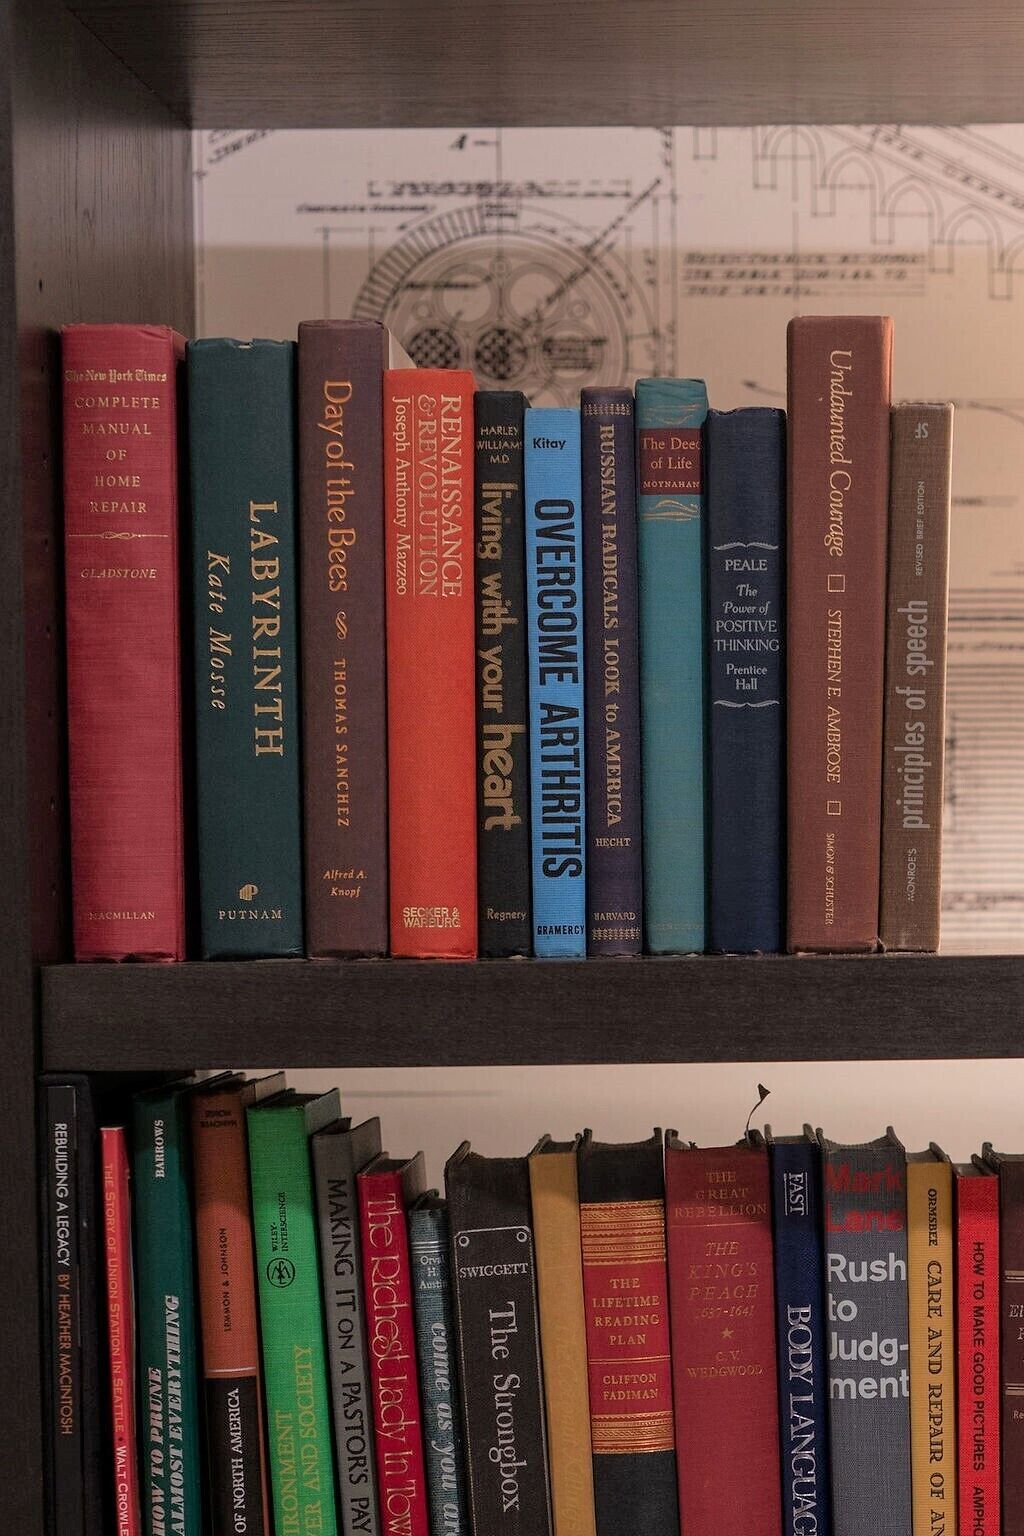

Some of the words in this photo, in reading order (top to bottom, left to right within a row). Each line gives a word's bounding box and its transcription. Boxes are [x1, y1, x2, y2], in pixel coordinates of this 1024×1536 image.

[75, 397, 160, 409] COMPLETE
[319, 380, 352, 437] Day
[393, 396, 411, 454] Joseph
[417, 394, 434, 413] &
[829, 350, 852, 465] Undaunted
[83, 424, 152, 435] MANUAL
[533, 437, 566, 451] Kitay
[107, 450, 127, 461] OF
[325, 442, 353, 470] of
[599, 425, 615, 514] RUSSIAN
[95, 476, 140, 487] HOME
[327, 475, 355, 522] the
[393, 458, 411, 527] Anthony
[440, 394, 462, 598] RENAISSANCE
[90, 502, 147, 513] REPAIR
[418, 420, 437, 596] REVOLUTION
[477, 482, 517, 560] living
[824, 469, 851, 557] Courage
[327, 527, 356, 592] Bees
[394, 533, 408, 595] Mazzeo
[602, 523, 617, 629] RADICALS
[725, 560, 767, 571] PEALE
[207, 551, 230, 613] Kate
[481, 572, 517, 635] with
[536, 499, 578, 685] OVERCOME
[737, 585, 757, 597] The
[250, 500, 283, 757] LABYRINTH
[716, 620, 777, 633] POSITIVE
[722, 602, 757, 614] Power
[759, 602, 769, 614] of
[714, 639, 780, 651] THINKING
[898, 600, 934, 675] speech
[209, 627, 232, 710] Mosse
[477, 643, 503, 712] your
[605, 638, 618, 698] LOOK
[726, 664, 768, 675] Prentice
[736, 679, 757, 691] Hall
[606, 703, 617, 722] to
[896, 686, 925, 711] of
[484, 724, 524, 831] heart
[539, 702, 582, 878] ARTHRITIS
[606, 724, 620, 827] AMERICA
[895, 721, 931, 830] principles
[219, 910, 282, 921] PUTNAM
[328, 1178, 353, 1276] MAKING
[827, 1253, 906, 1281] Rush
[973, 1241, 984, 1275] HOW
[335, 1289, 356, 1311] IT
[592, 1295, 659, 1308] LIFETIME
[610, 1278, 640, 1289] THE
[927, 1261, 942, 1319] CARE
[973, 1280, 984, 1300] TO
[489, 1301, 516, 1359] The
[595, 1315, 659, 1327] READING
[829, 1297, 857, 1322] to
[973, 1305, 984, 1349] MAKE
[338, 1318, 353, 1349] ON
[609, 1334, 646, 1346] PLAN
[787, 1304, 812, 1384] BODY
[829, 1331, 910, 1366] Judg-
[928, 1328, 942, 1373] AND
[341, 1361, 352, 1375] A
[829, 1373, 910, 1399] ment
[973, 1353, 984, 1395] GOOD
[228, 1388, 242, 1455] AMERICA
[342, 1382, 368, 1485] PASTOR'S
[489, 1373, 526, 1513] Strongbox
[928, 1382, 944, 1463] REPAIR
[973, 1399, 984, 1471] PICTURES
[230, 1458, 245, 1508] NORTH
[929, 1473, 944, 1500] OF
[234, 1513, 246, 1533] OF
[351, 1496, 371, 1534] PAY
